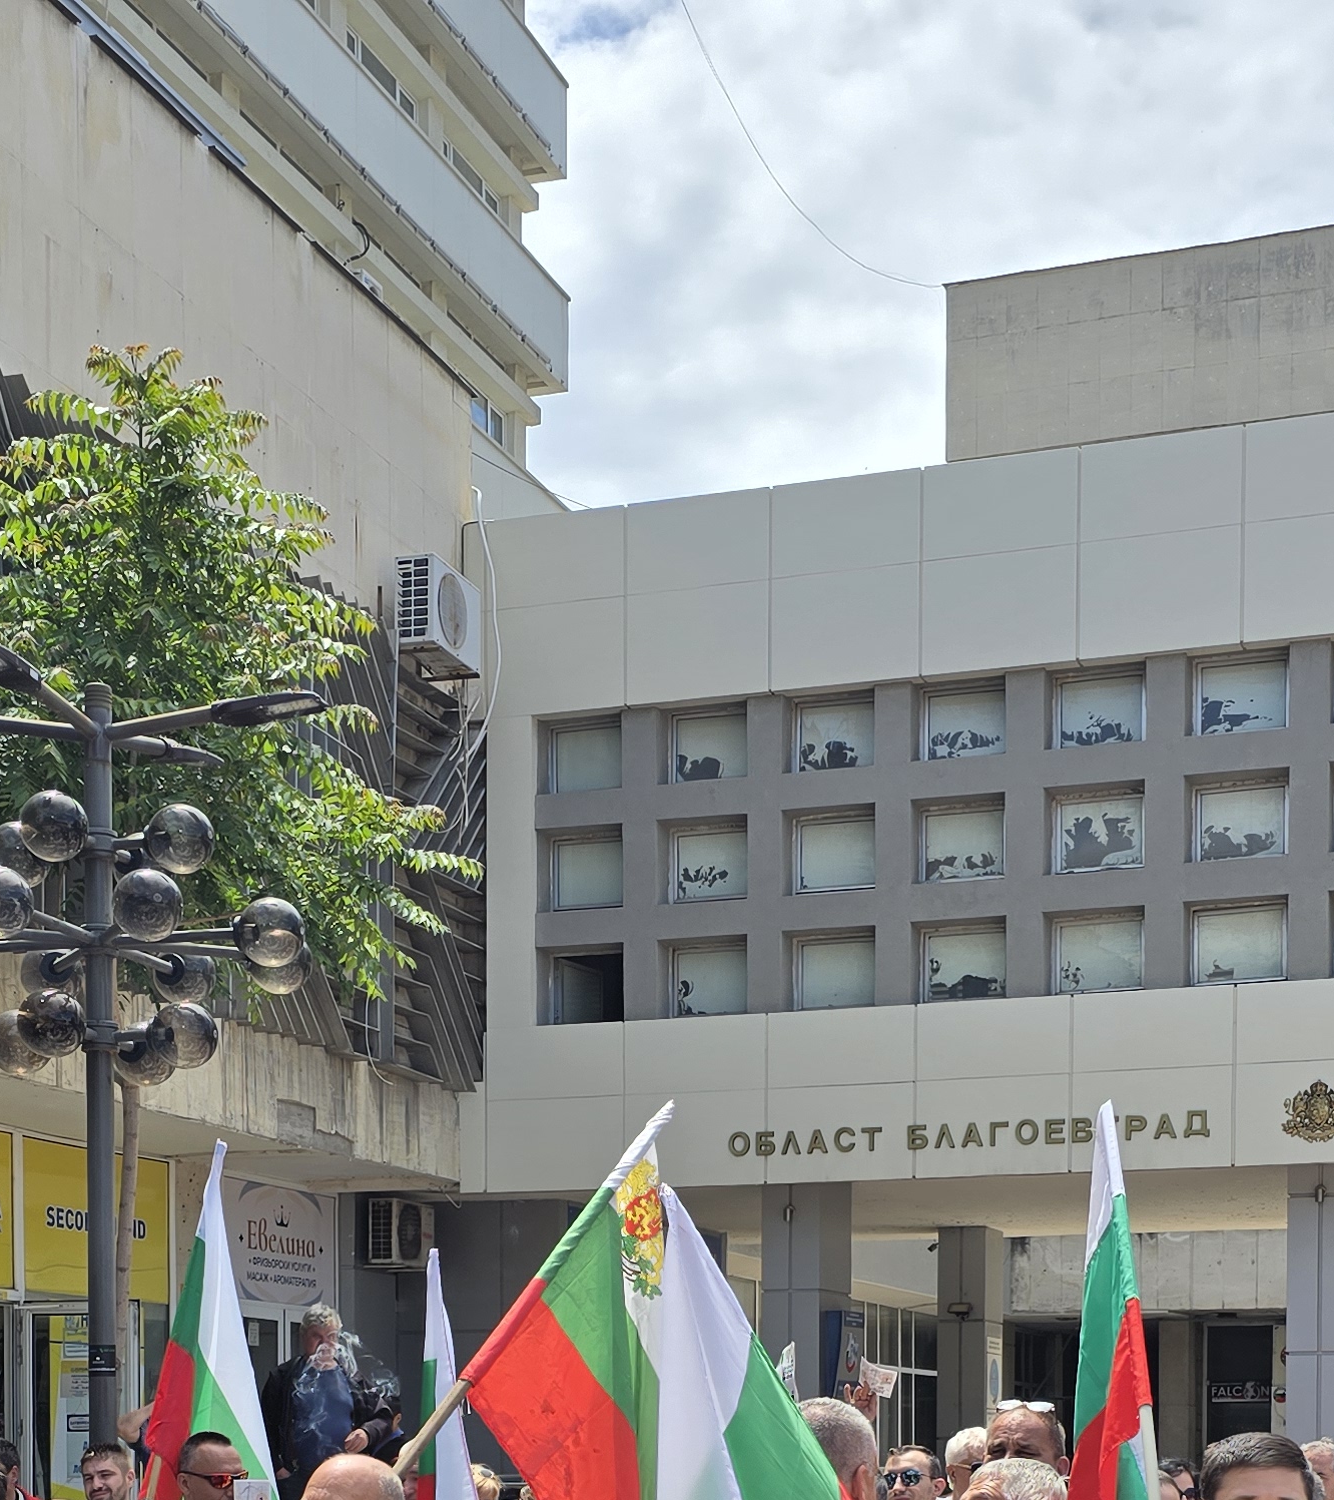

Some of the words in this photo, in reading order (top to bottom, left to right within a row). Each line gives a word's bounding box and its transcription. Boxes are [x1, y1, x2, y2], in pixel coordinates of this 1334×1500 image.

[728, 1126, 883, 1157] ОБЛАСТ
[907, 1110, 1210, 1150] БЛАГОЕВРАД
[46, 1206, 89, 1232] SECO
[247, 1218, 315, 1258] Евелина
[1211, 1382, 1269, 1400] FALCON
